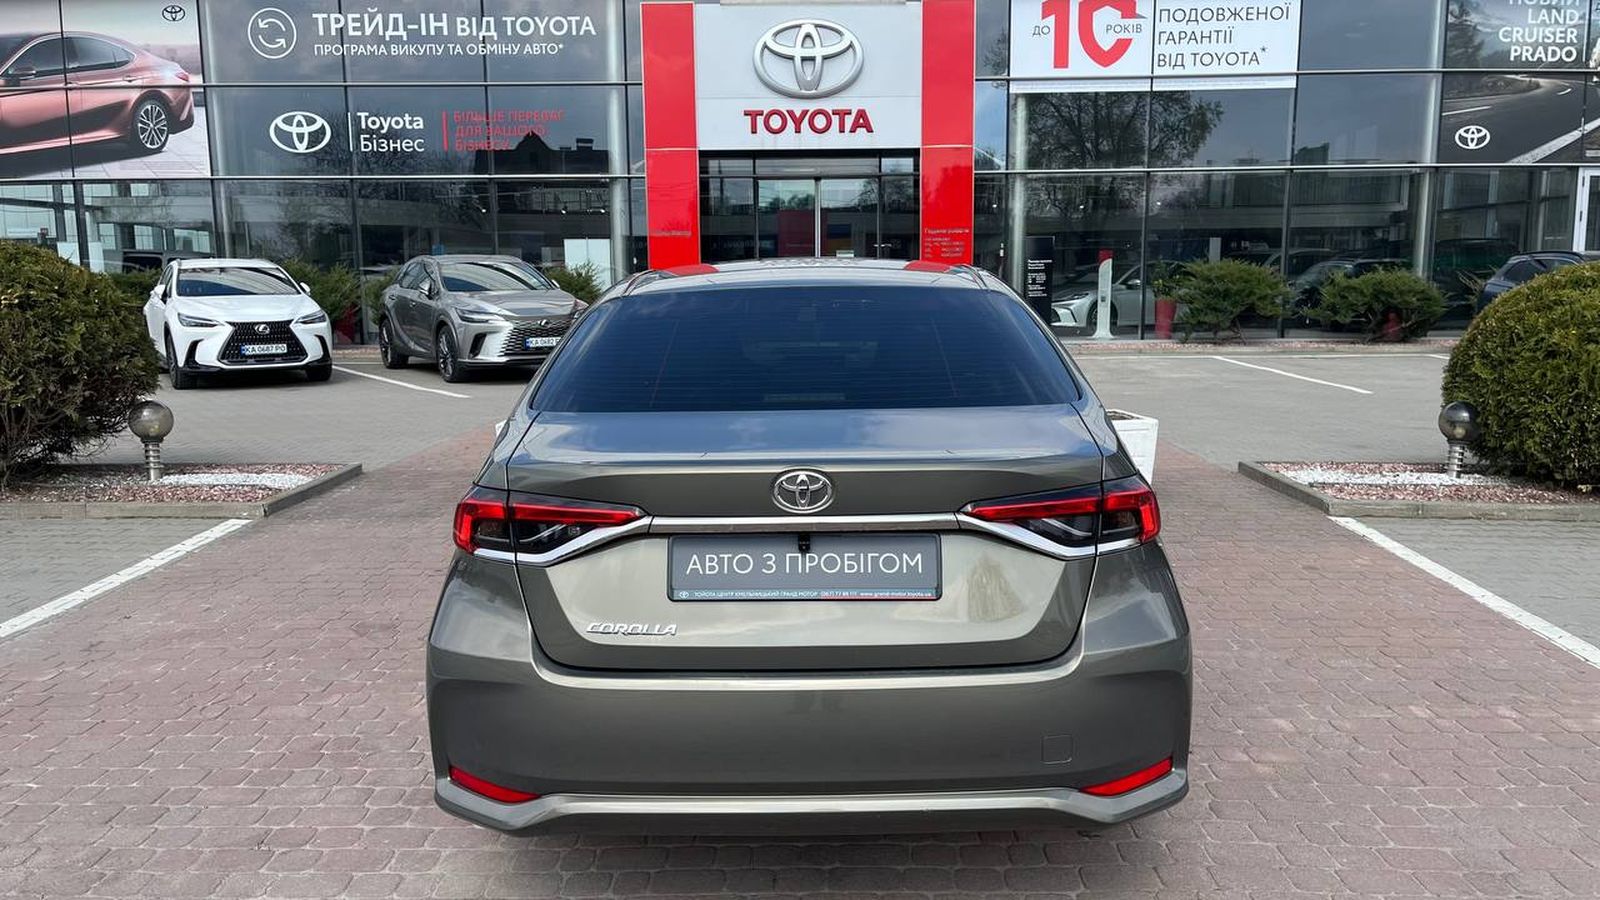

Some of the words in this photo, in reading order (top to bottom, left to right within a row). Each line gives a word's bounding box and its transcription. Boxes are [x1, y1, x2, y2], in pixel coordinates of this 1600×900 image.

[1159, 2, 1291, 25] ПОДОВЖЕНОЇ
[1528, 8, 1579, 24] LAND
[312, 7, 448, 41] ТРЕЙД-ІН
[456, 17, 497, 40] ВІД
[502, 16, 597, 36] TOYOTA
[1032, 25, 1051, 37] ДО
[1105, 24, 1142, 34] РОКІВ
[1158, 26, 1234, 45] ГАРАНТІЇ
[1499, 27, 1577, 43] CRUISER
[314, 44, 388, 56] ПРОГРАМА
[390, 44, 444, 55] ВИКУПУ
[447, 44, 463, 55] ТА
[466, 43, 520, 55] ОБМІНУ
[1510, 46, 1577, 62] PRADO
[1157, 53, 1185, 69] ВІД
[357, 112, 424, 133] Toyota
[743, 108, 874, 134] TOYOTA
[360, 135, 425, 152] Бізнес
[686, 553, 754, 575] АВТО
[762, 553, 777, 574] З
[785, 552, 922, 573] ПРОБІГОМ
[586, 622, 678, 636] COROLLA
